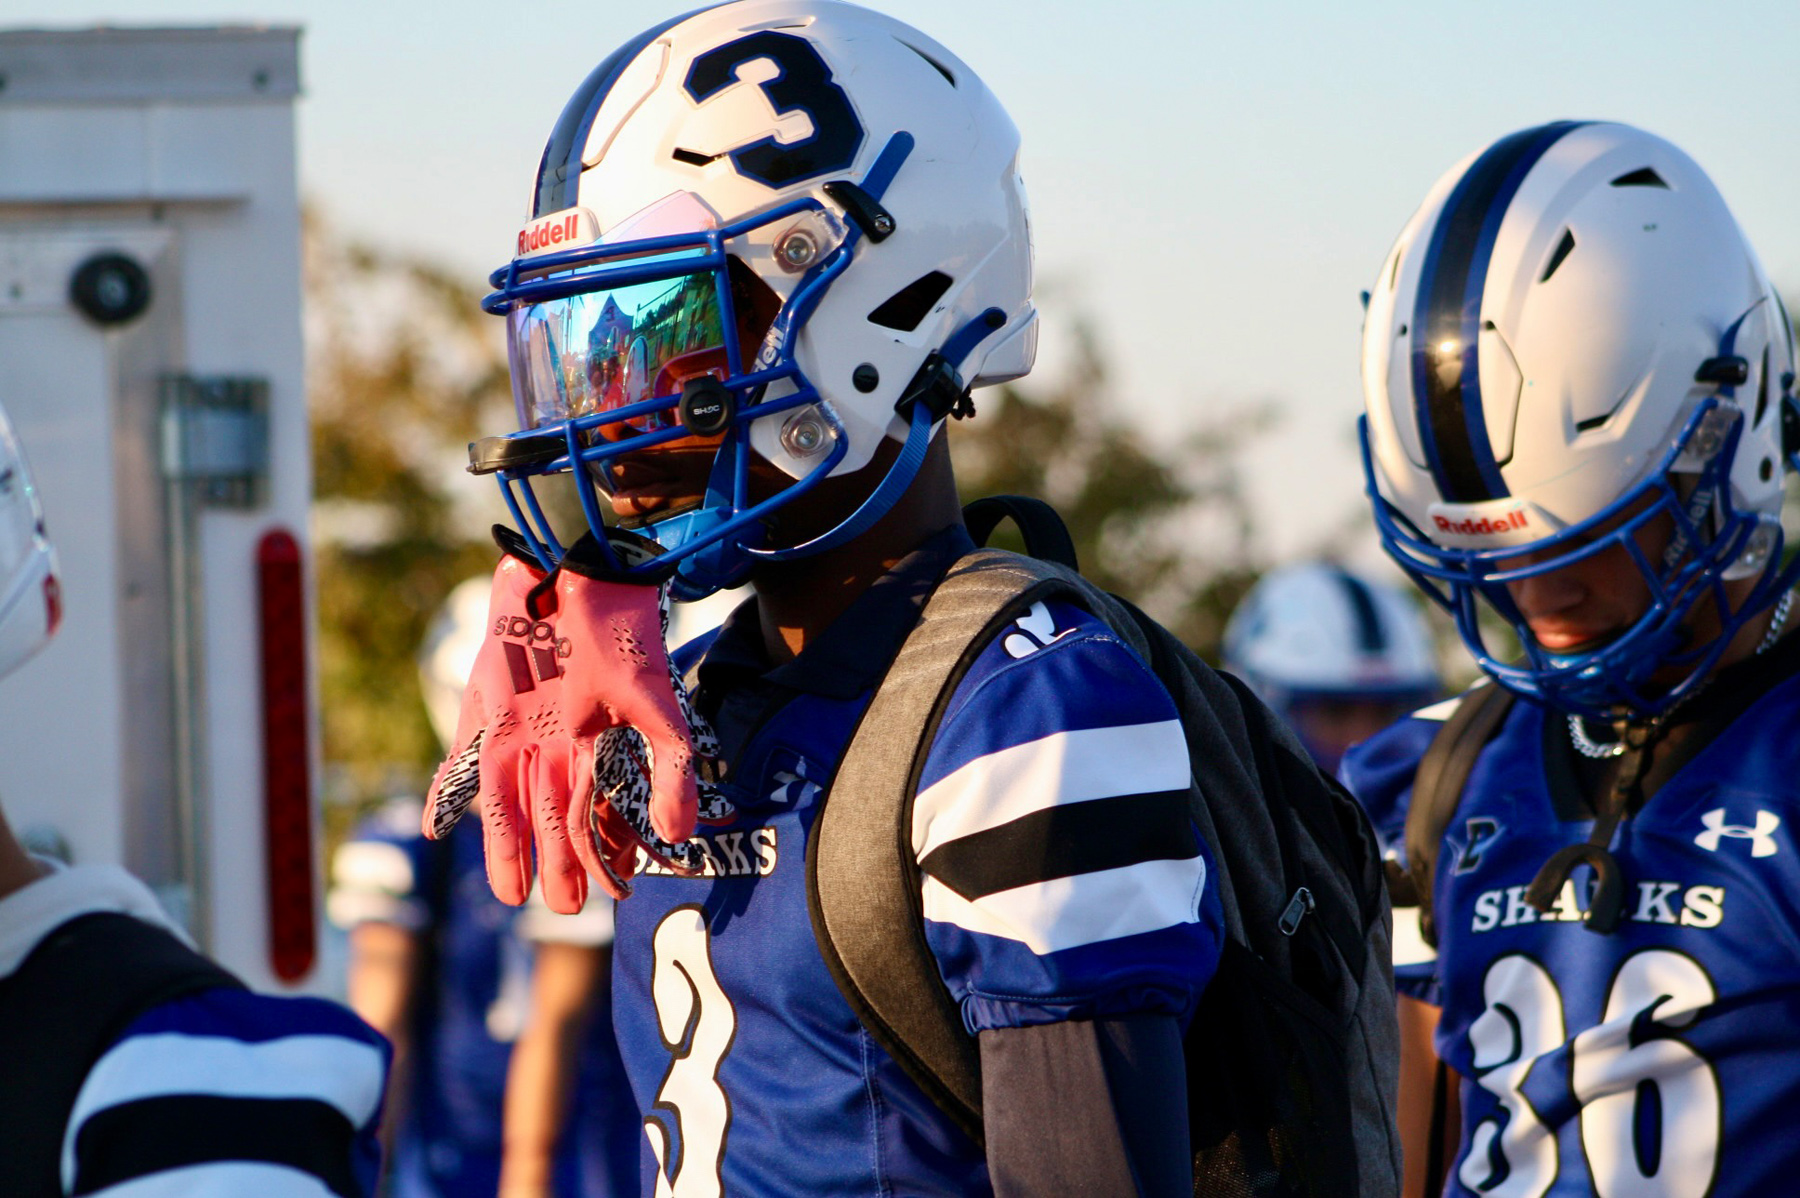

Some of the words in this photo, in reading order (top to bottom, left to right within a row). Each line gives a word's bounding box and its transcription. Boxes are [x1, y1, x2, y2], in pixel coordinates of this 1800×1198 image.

[683, 30, 865, 190] 3
[518, 213, 579, 256] Riddell
[1432, 509, 1528, 535] Riddell
[1471, 878, 1725, 934] SHAKS
[644, 902, 739, 1198] 3
[1458, 947, 1722, 1198] 36
